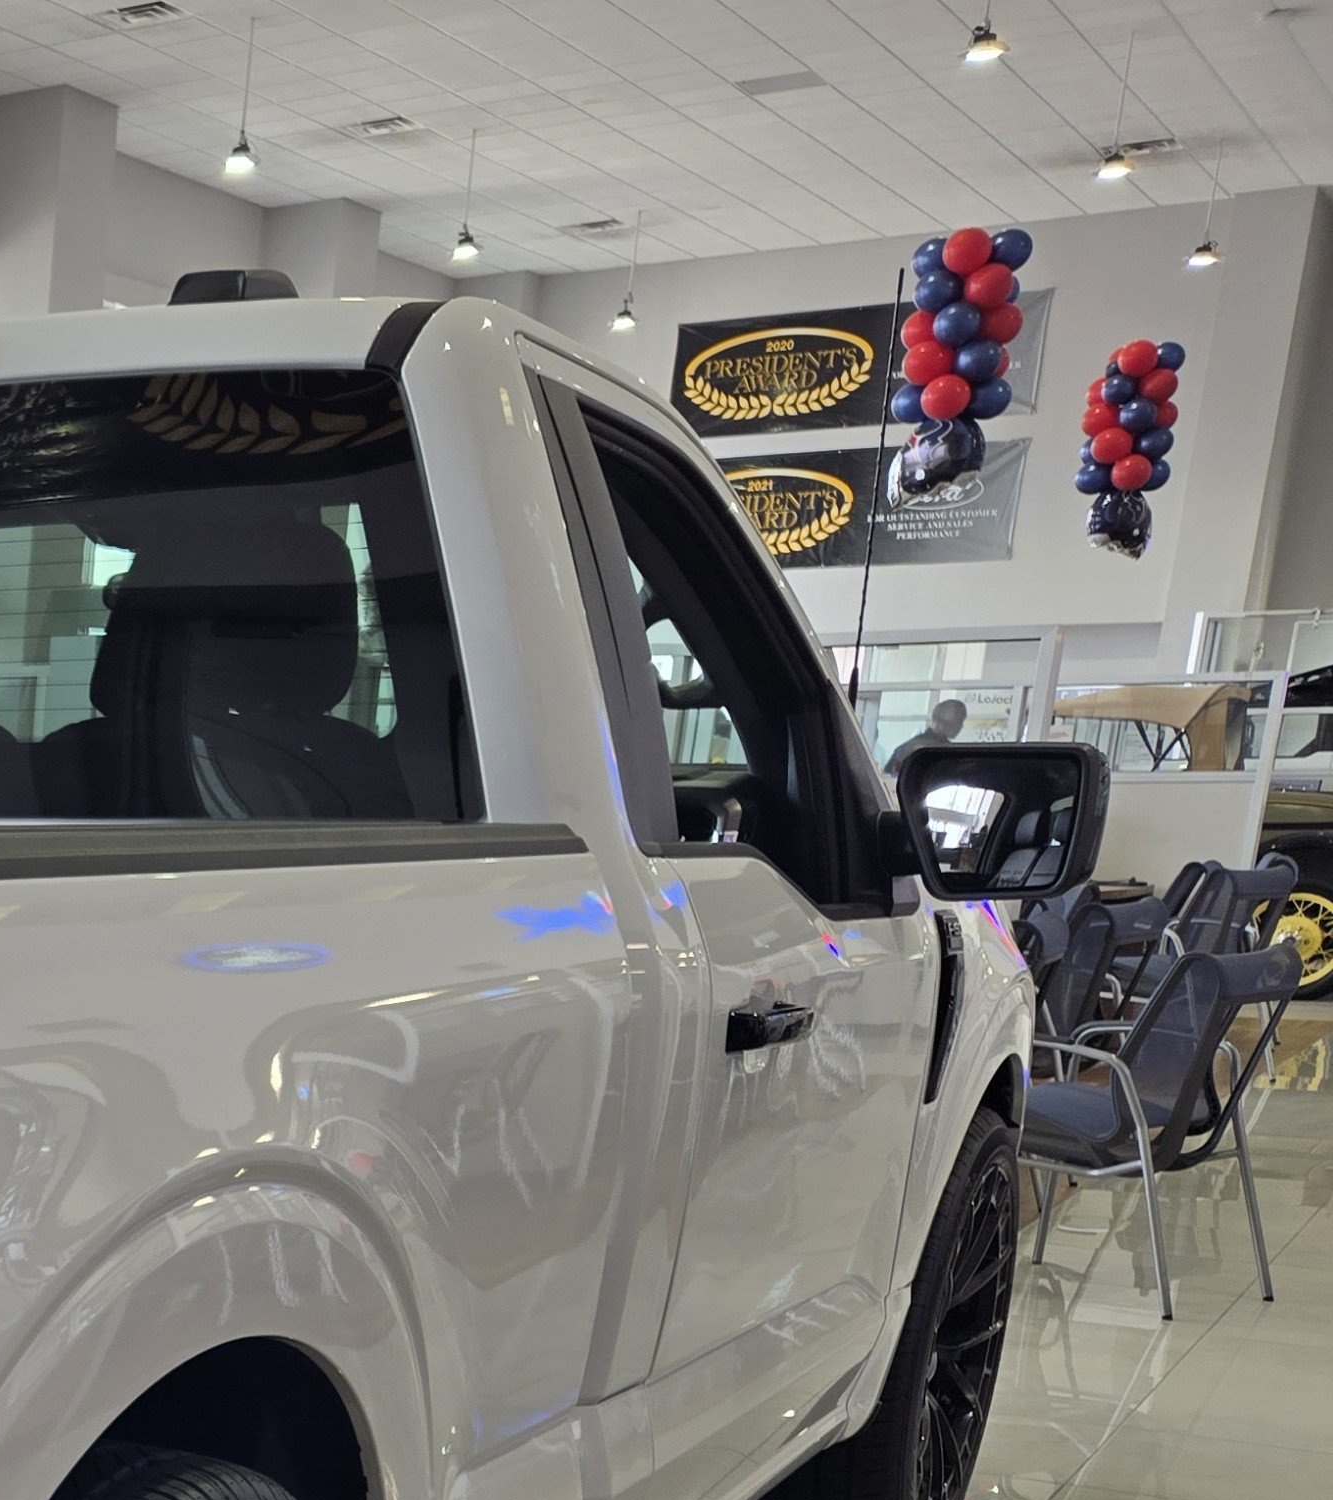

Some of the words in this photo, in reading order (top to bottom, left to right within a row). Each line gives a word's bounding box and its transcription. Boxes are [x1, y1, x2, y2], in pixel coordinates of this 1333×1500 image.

[766, 339, 794, 352] 2020
[704, 347, 857, 379] PRESIDENT'S
[733, 369, 817, 394] AWARD
[747, 479, 773, 491] 2021
[896, 530, 960, 540] PERFORMANCE
